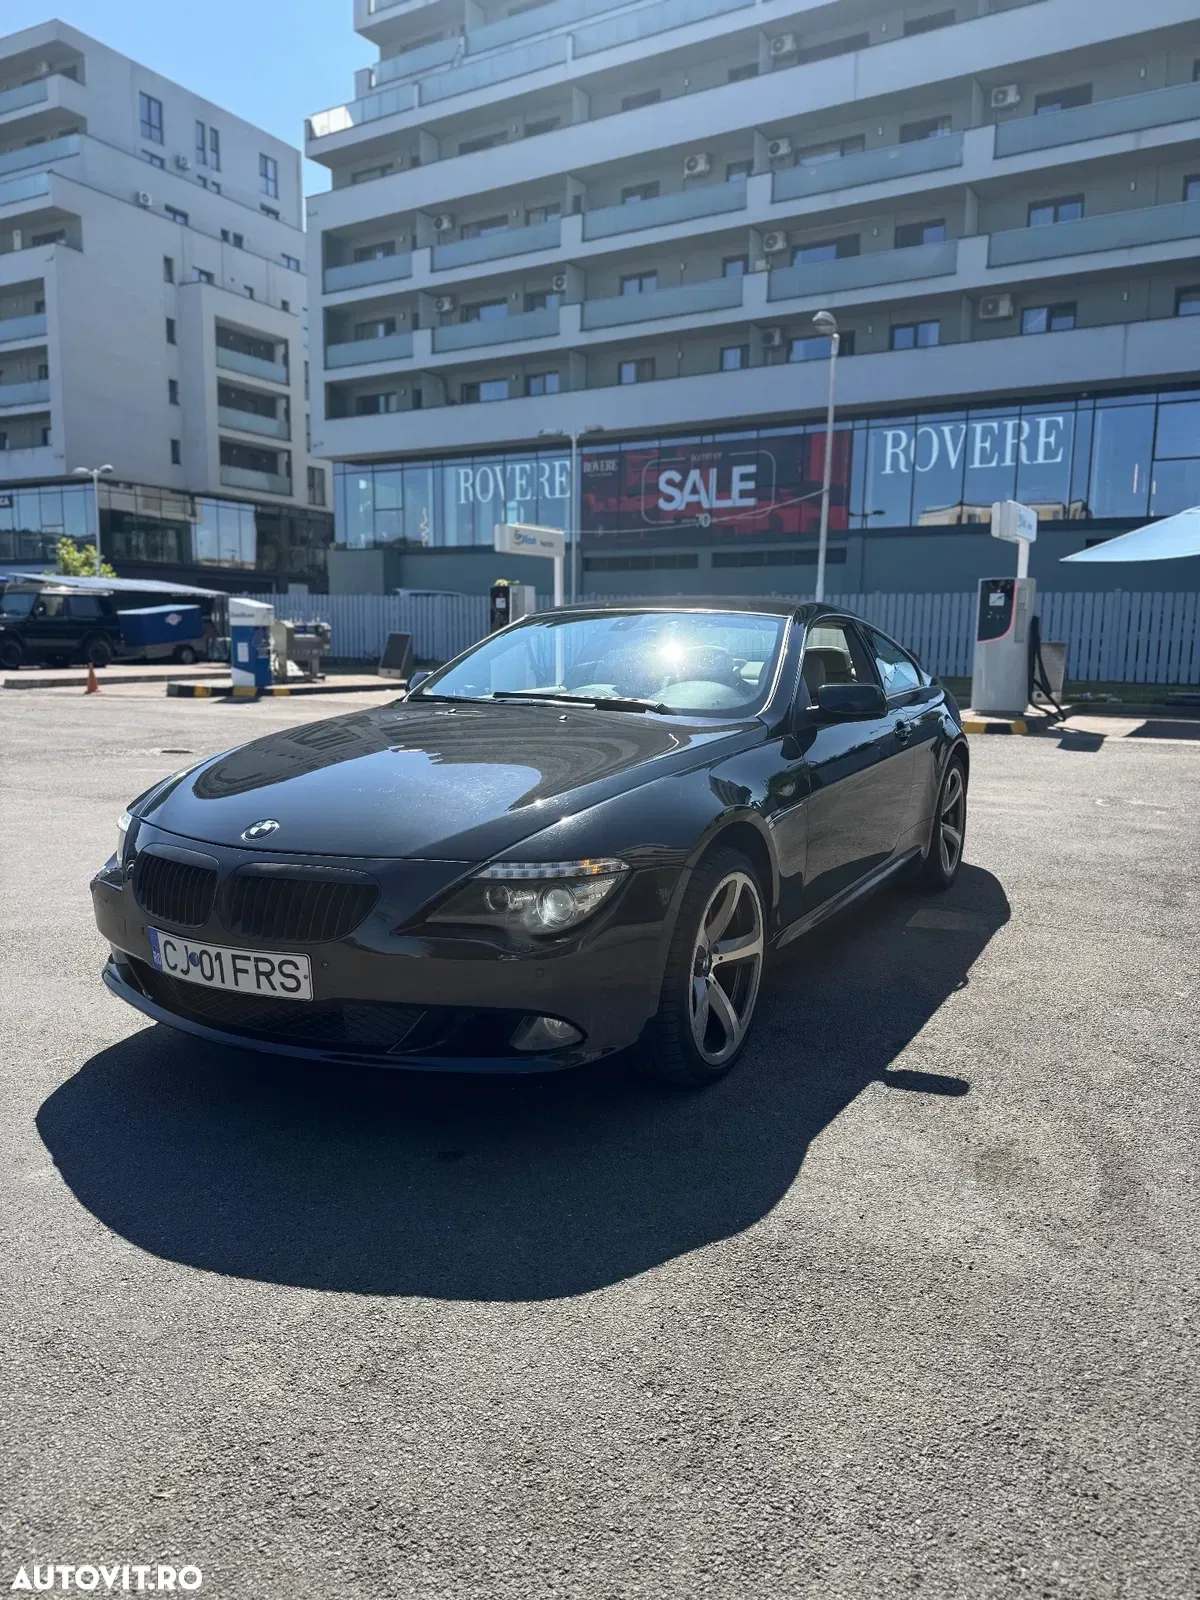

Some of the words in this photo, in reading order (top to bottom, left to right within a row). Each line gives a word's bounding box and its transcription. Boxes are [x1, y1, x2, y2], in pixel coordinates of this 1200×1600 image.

[881, 416, 1064, 475] ROVERE
[458, 460, 571, 504] ROVERE
[658, 464, 758, 511] SALE
[163, 939, 190, 976] CJ
[200, 949, 226, 984] 01
[231, 953, 302, 993] FRS
